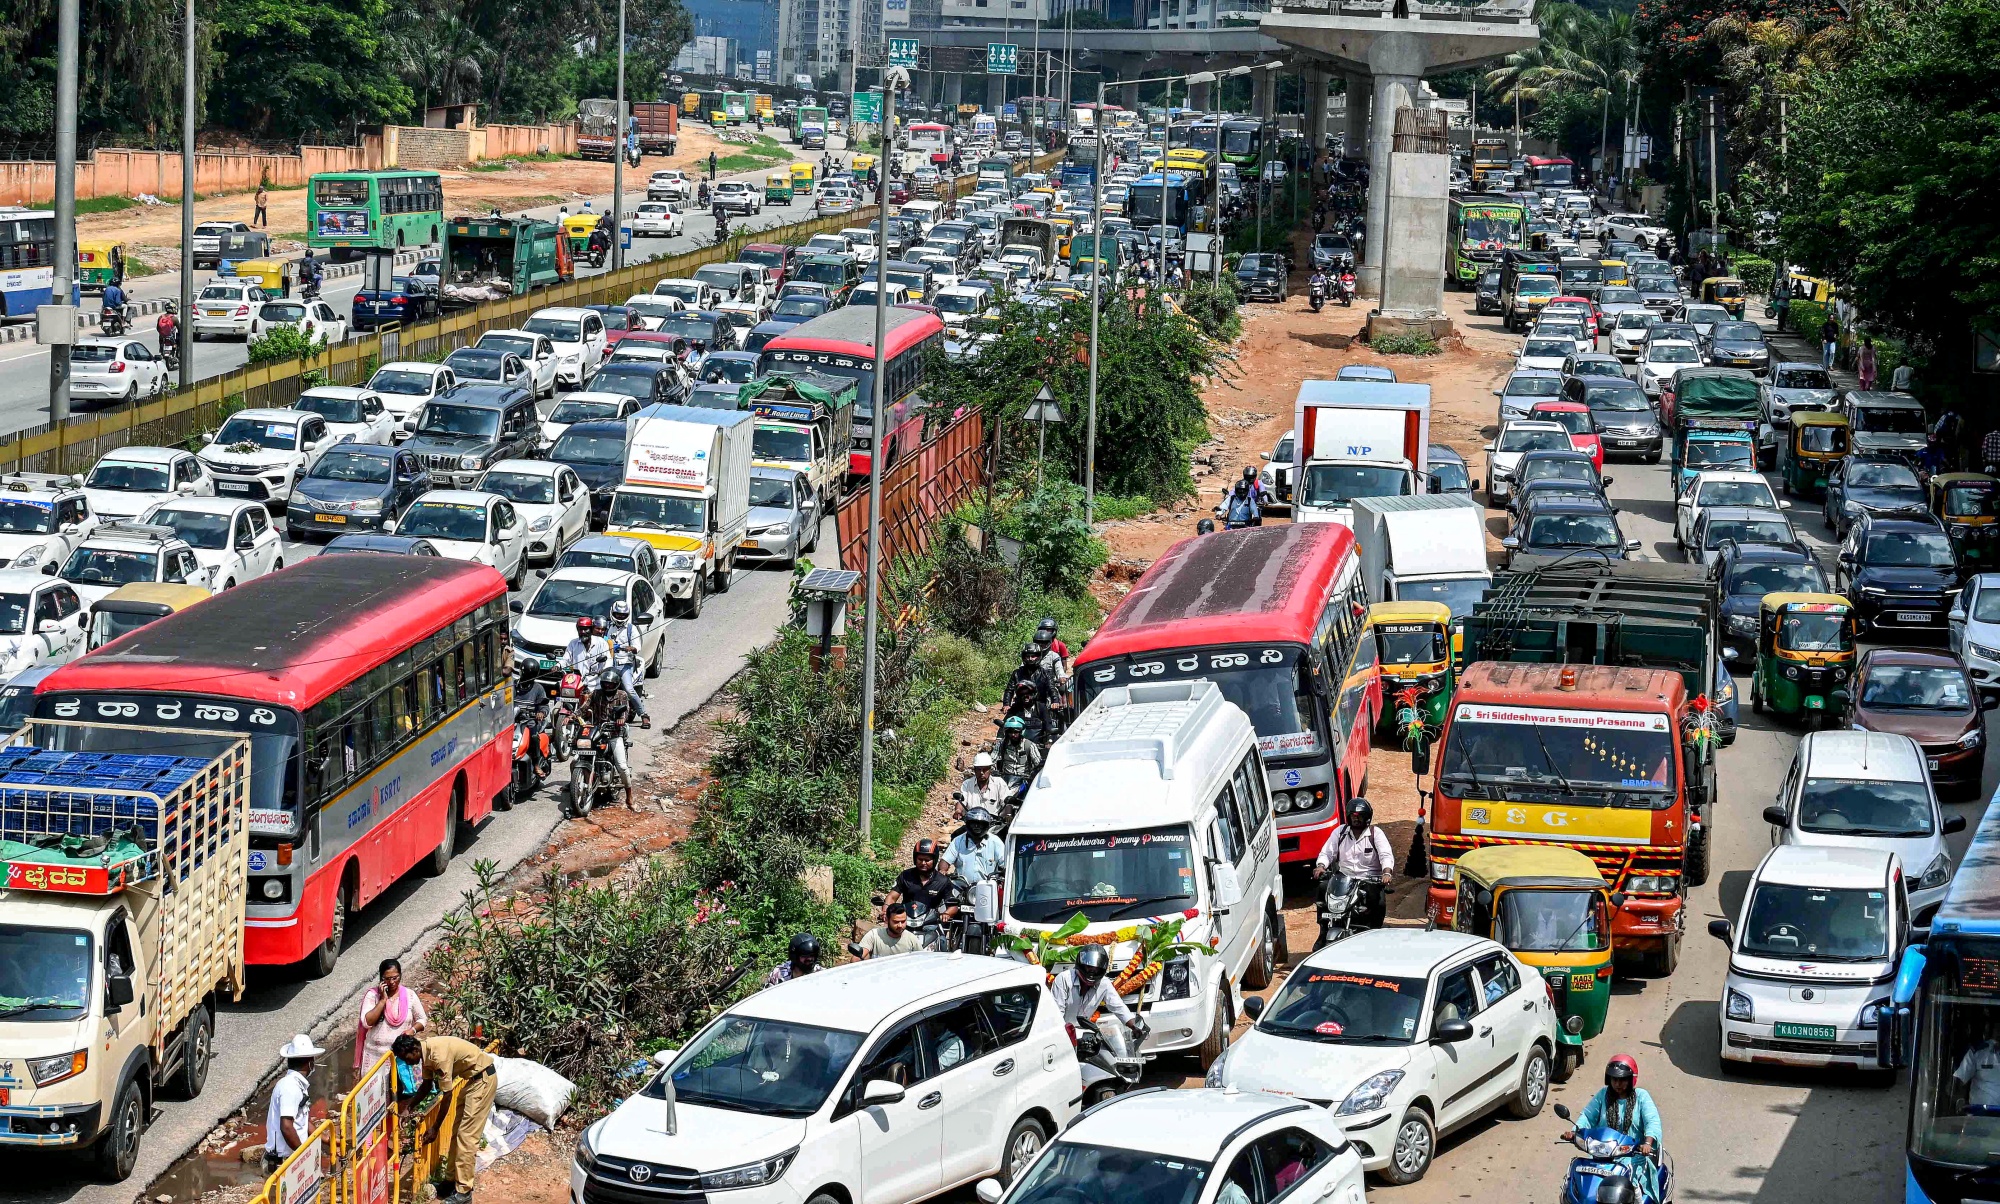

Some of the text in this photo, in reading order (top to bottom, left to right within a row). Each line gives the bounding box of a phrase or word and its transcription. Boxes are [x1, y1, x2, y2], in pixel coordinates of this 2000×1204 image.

[638, 465, 697, 477] PROFESSIONAL
[5, 688, 20, 697] 05
[1476, 710, 1645, 728] Sri Siddeshwara Swamy Prasanna
[380, 776, 402, 805] KSRTC
[1621, 779, 1650, 787] BBMP
[1507, 808, 1568, 826] S G
[1018, 833, 1184, 854] Sri Nanjundeshwara Swamy Prasanna
[1574, 975, 1592, 983] KA03
